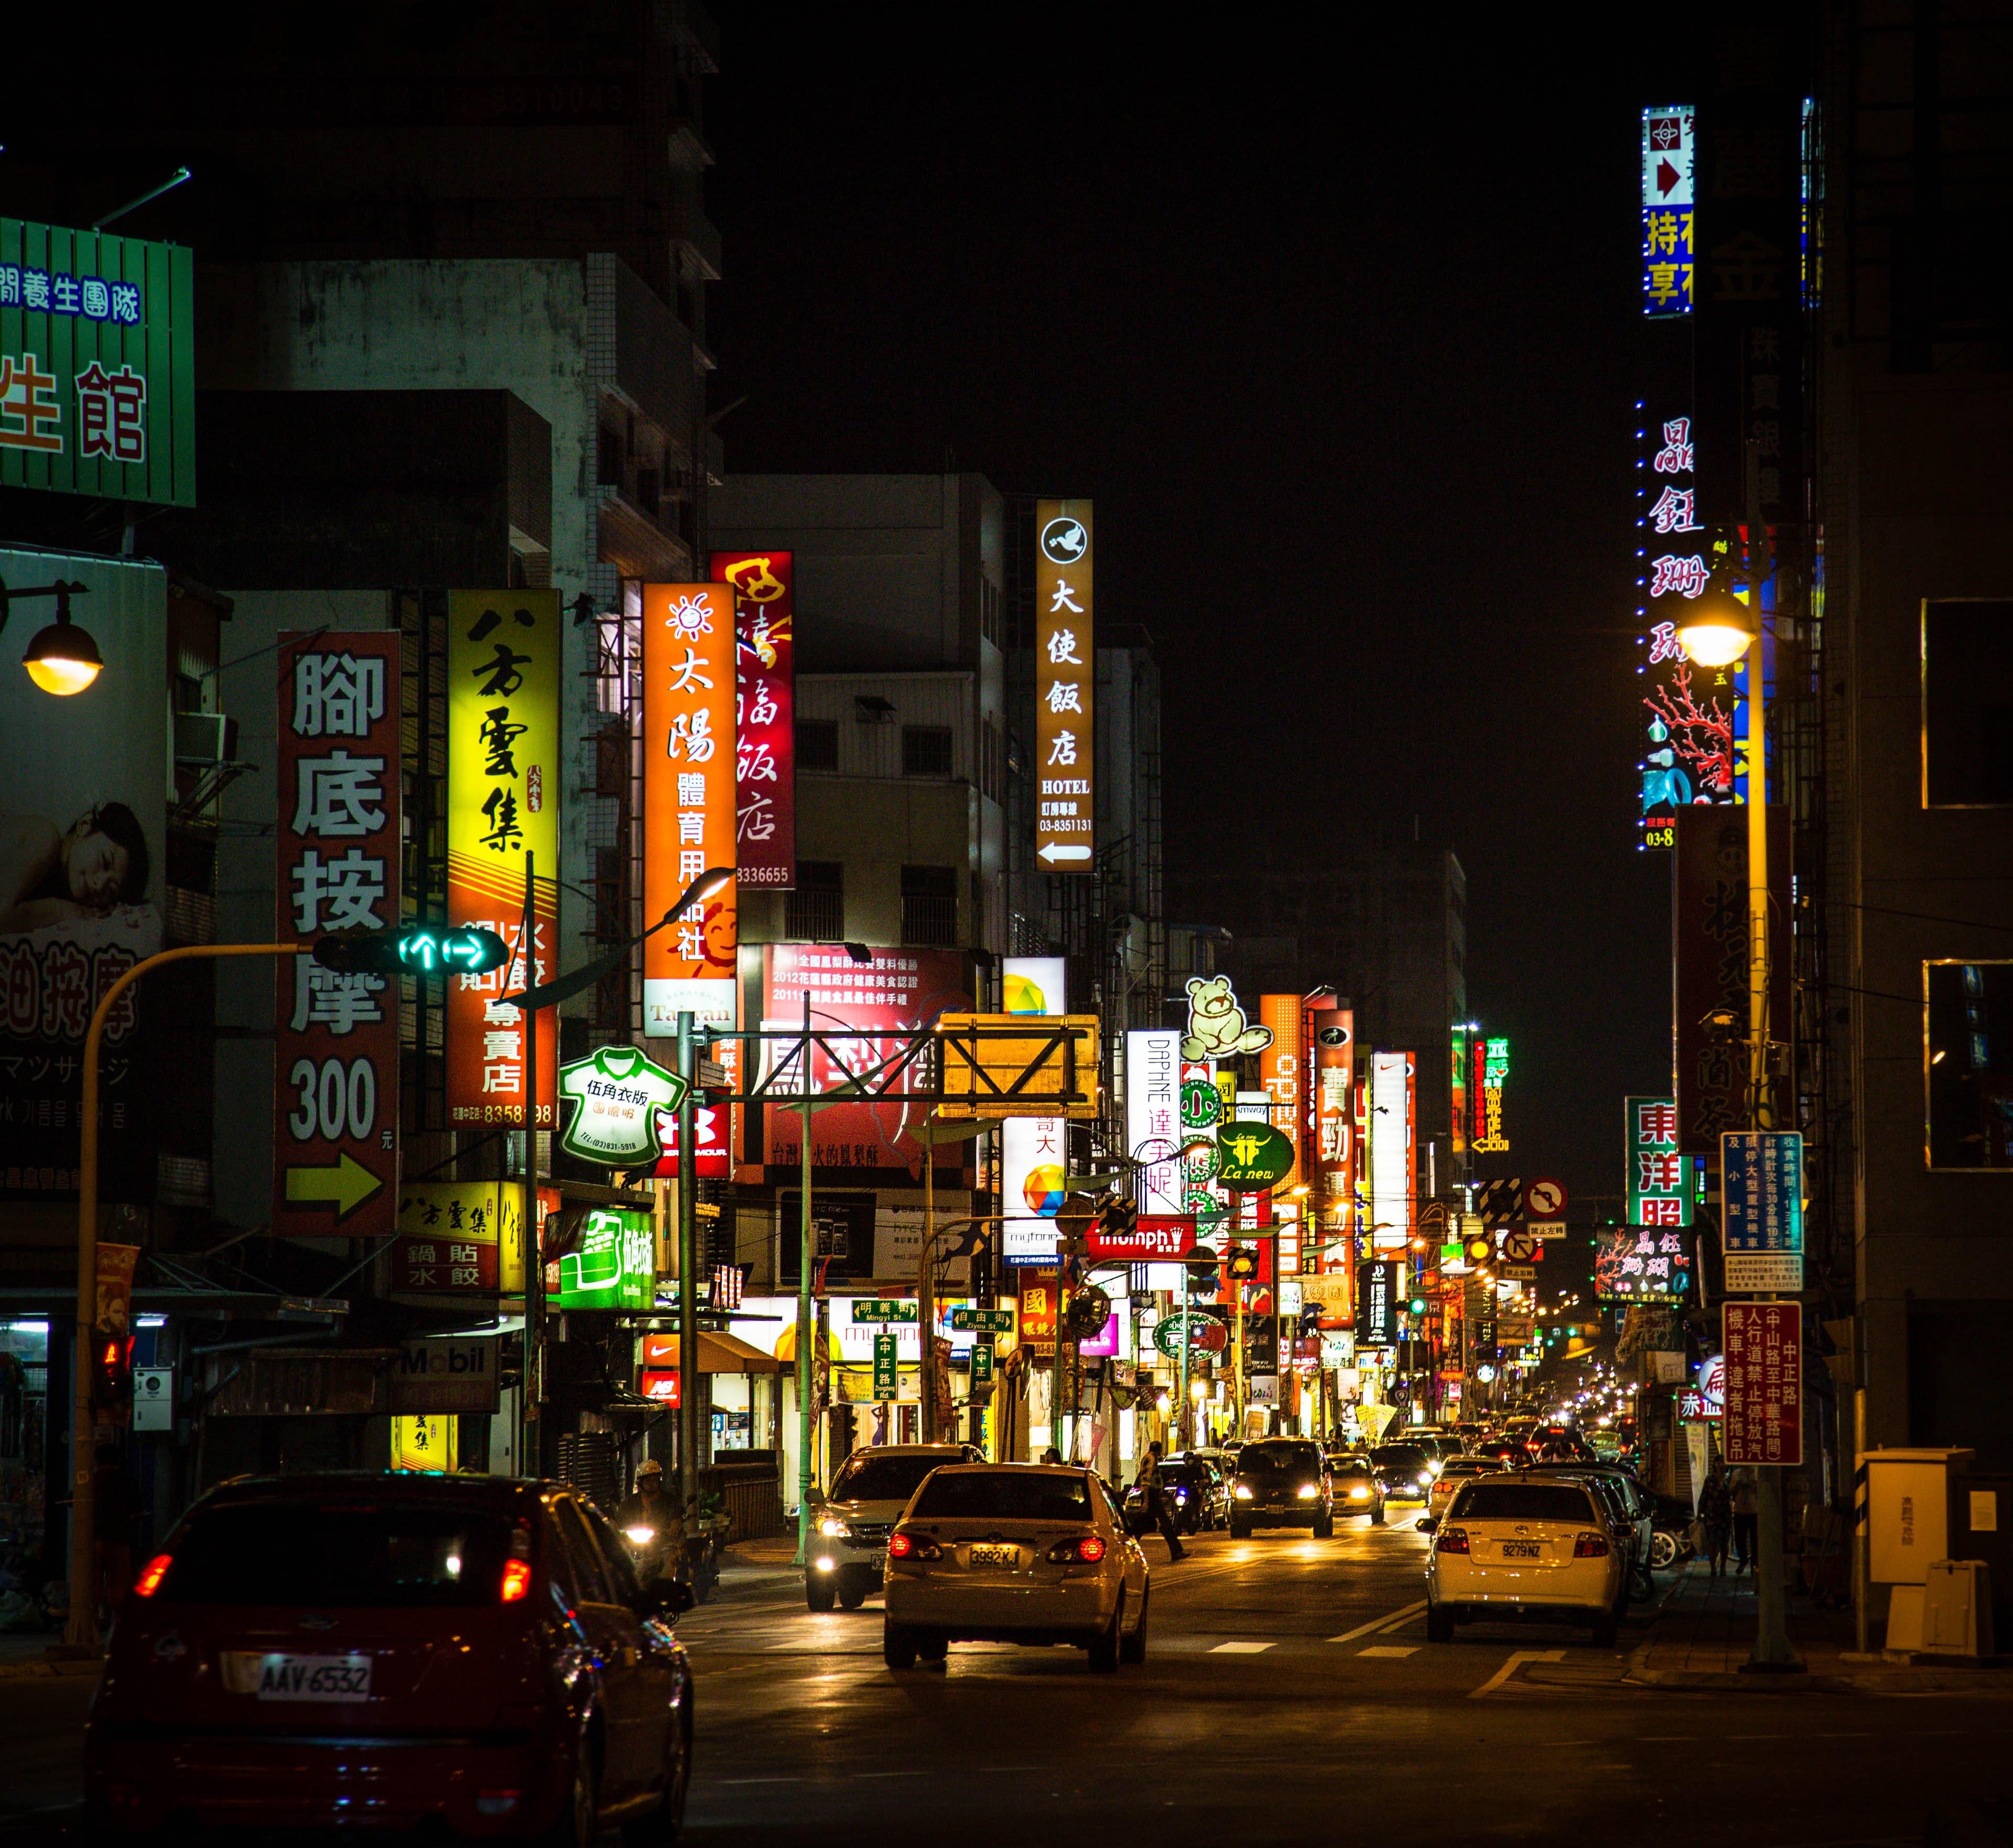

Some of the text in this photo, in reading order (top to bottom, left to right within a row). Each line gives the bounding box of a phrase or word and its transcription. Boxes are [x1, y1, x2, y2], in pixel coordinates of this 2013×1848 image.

[1046, 579, 1083, 766] 大使飯店
[468, 608, 534, 852] 八方雲集
[1042, 779, 1089, 795] HOTEL
[1040, 819, 1091, 832] 03-8351131
[482, 998, 522, 1093] 專賣店
[1148, 1040, 1170, 1103] DAPHNE
[290, 1059, 393, 1150] 300 元
[484, 1104, 551, 1123] 835898
[1236, 1106, 1267, 1115] Amway
[1218, 1165, 1274, 1180] La new
[1011, 1233, 1058, 1243] myfone
[406, 1244, 478, 1263] 鍋貼
[408, 1267, 480, 1286] 水餃
[860, 1302, 910, 1314] 明義街
[959, 1311, 1005, 1322] 自由街
[866, 1314, 891, 1322] Mingyi
[401, 1347, 484, 1374] Mobil
[879, 1342, 891, 1385] 中正路
[1782, 1340, 1798, 1406] 中正路
[1747, 1308, 1763, 1460] 人行道禁止停放汽
